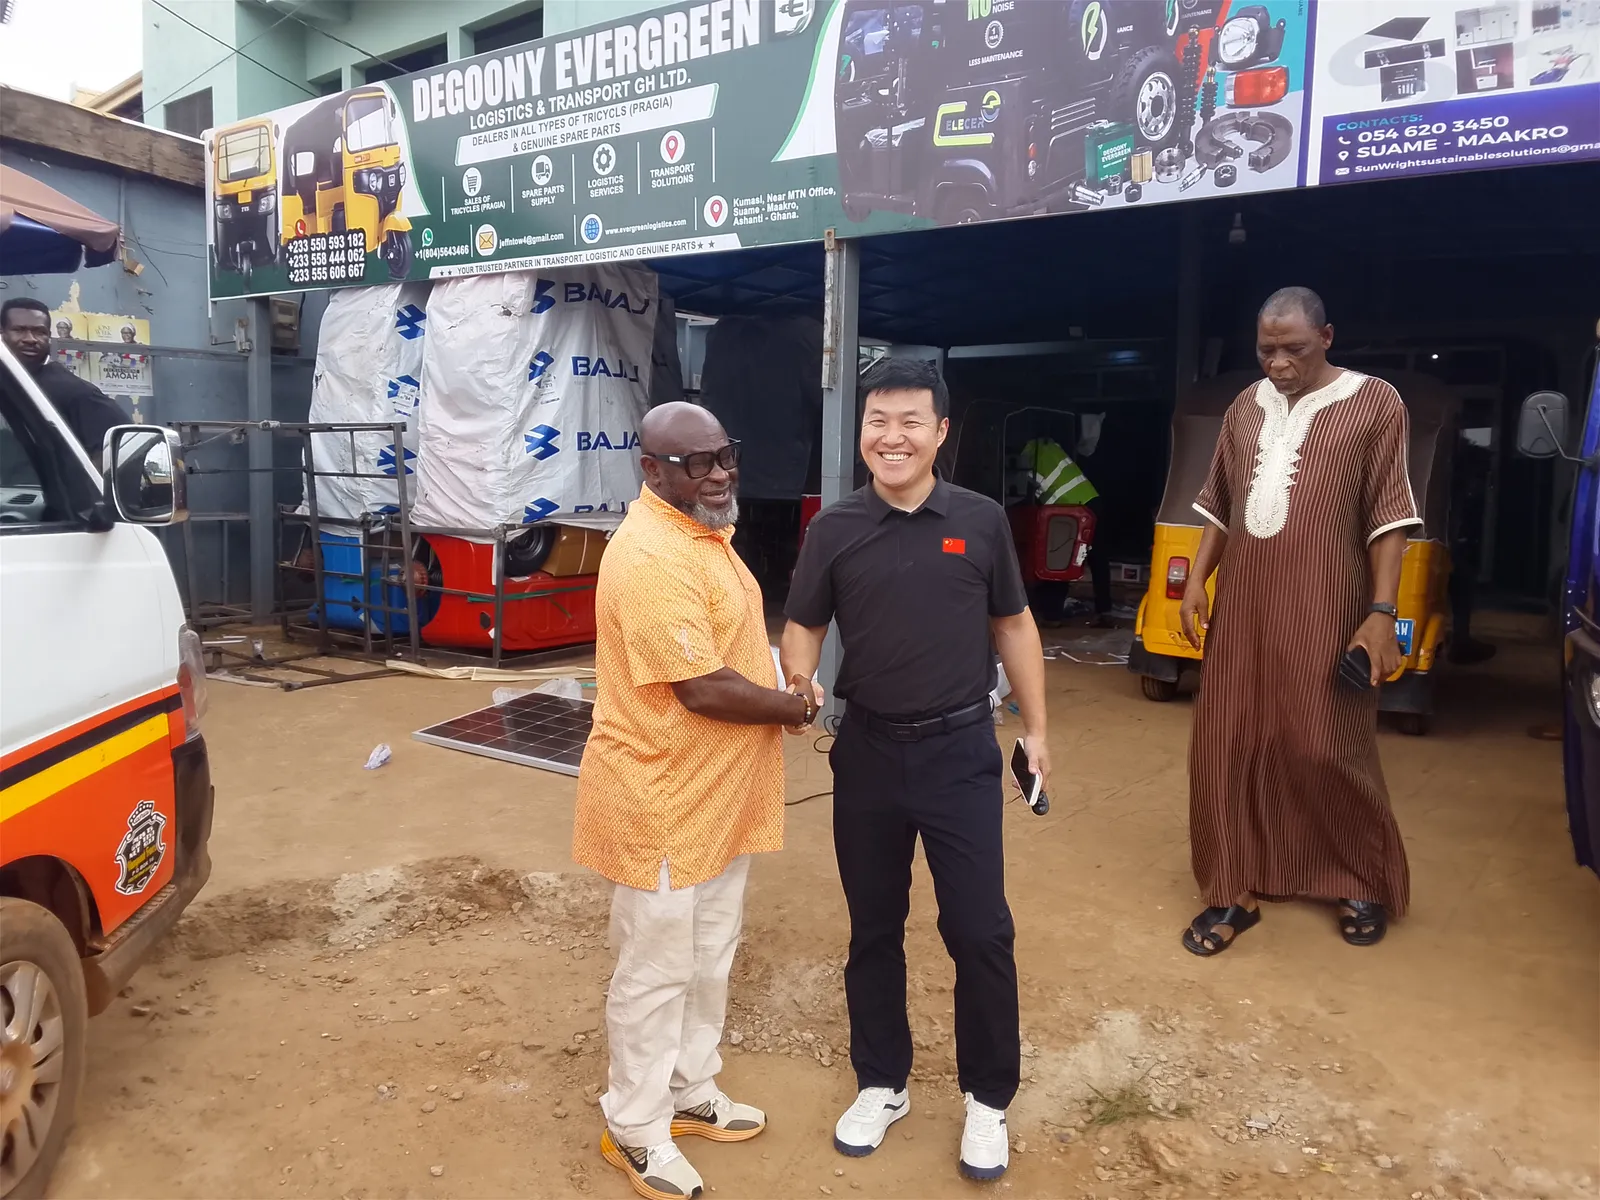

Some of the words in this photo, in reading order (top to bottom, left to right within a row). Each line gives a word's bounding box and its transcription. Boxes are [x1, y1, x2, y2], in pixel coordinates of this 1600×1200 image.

[992, 1, 1015, 14] NOISE
[412, 46, 546, 122] DEGOONY
[555, 0, 760, 91] EVERGREEN
[968, 58, 981, 67] LESS
[981, 49, 1024, 64] MAINTENANCE
[470, 102, 533, 130] LOGISTICS
[536, 98, 546, 116] &
[548, 80, 630, 113] TRANSPORT
[634, 73, 655, 94] GH
[660, 67, 692, 90] LTD.
[472, 131, 508, 146] DEALERS
[510, 128, 519, 139] IN
[520, 124, 535, 137] ALL
[538, 118, 566, 133] TYPES
[568, 116, 580, 128] OF
[582, 106, 627, 124] TRICYCLS
[629, 95, 673, 117] (PRAGIA)
[1336, 114, 1423, 132] CONTACTS:
[1357, 129, 1399, 143] 054
[1404, 122, 1447, 138] 620
[1451, 115, 1509, 132] 3450
[512, 143, 519, 153] &
[521, 136, 558, 152] GENUINE
[560, 129, 590, 144] SPARE
[591, 122, 621, 138] PARTS
[1356, 138, 1438, 158] SUAME
[1457, 125, 1568, 148] MAAKRO
[650, 162, 695, 178] TRANSPORT
[587, 175, 624, 189] LOGISTICS
[651, 174, 694, 189] SOLUTIONS
[521, 188, 542, 199] SPARE
[543, 184, 565, 196] PARTS
[589, 185, 624, 198] SERVICES
[733, 195, 765, 207] Kumasi,
[766, 192, 786, 202] Near
[787, 188, 806, 200] MTN
[808, 186, 837, 197] Office,
[451, 204, 480, 215] TRICYCLES
[481, 200, 506, 213] (PRAGIA)
[464, 197, 479, 206] SALES
[482, 195, 491, 203] OF
[531, 195, 556, 207] SUPPLY
[733, 206, 760, 217] Suame
[766, 201, 799, 212] Maakro,
[733, 215, 763, 226] Ashanti
[770, 211, 799, 221] Ghana.
[604, 219, 687, 235] www.evergreenlogistics.com
[287, 239, 309, 254] +233
[310, 237, 327, 251] 550
[328, 234, 345, 249] 593
[347, 232, 364, 247] 182
[288, 254, 309, 268] +233
[311, 252, 327, 266] 558
[328, 250, 346, 264] 444
[347, 248, 365, 262] 062
[414, 245, 469, 260] +1(804)5643466
[457, 266, 473, 275] YOUR
[475, 263, 502, 273] TRUSTED
[504, 259, 533, 270] PARTNER
[534, 258, 541, 267] IN
[542, 253, 584, 265] TRANSPORT,
[585, 249, 618, 262] LOGISTIC
[619, 247, 635, 257] AND
[636, 243, 669, 256] GENUINE
[671, 241, 697, 252] PARTS
[289, 268, 310, 282] +233
[311, 266, 328, 280] 555
[329, 265, 346, 279] 606
[348, 263, 365, 278] 667
[105, 371, 139, 380] AMOAH
